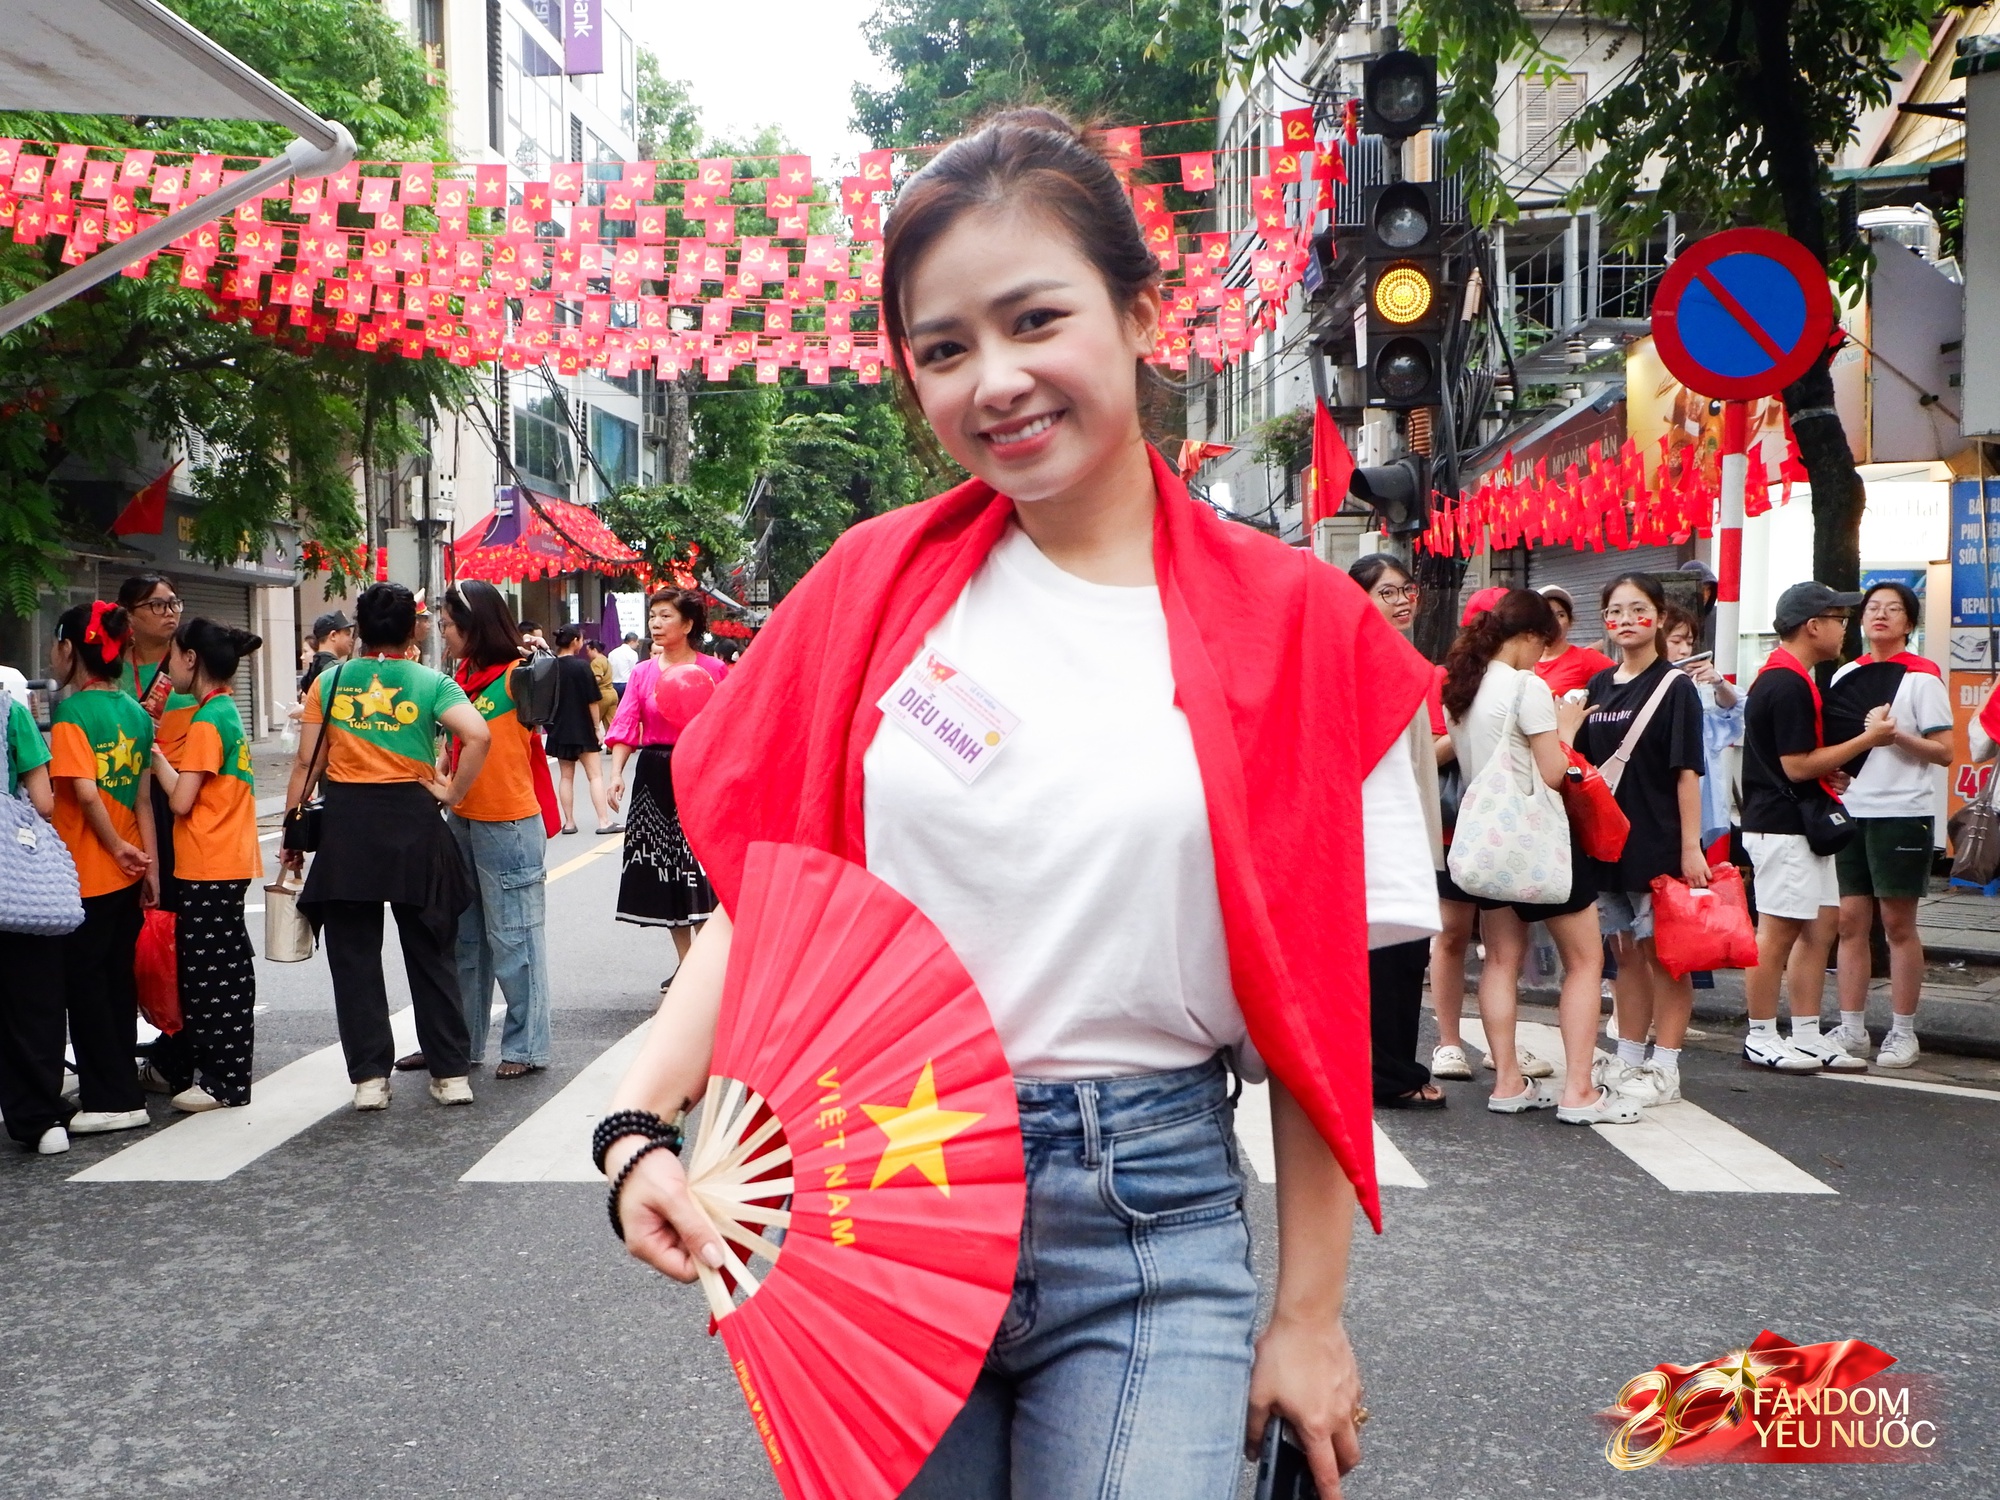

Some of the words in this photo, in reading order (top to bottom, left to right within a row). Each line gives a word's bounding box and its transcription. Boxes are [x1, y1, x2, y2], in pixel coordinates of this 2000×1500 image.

[573, 0, 593, 38] ank
[1959, 543, 1978, 567] SỬA
[814, 1065, 848, 1150] VIỆT
[824, 1163, 856, 1247] NAM
